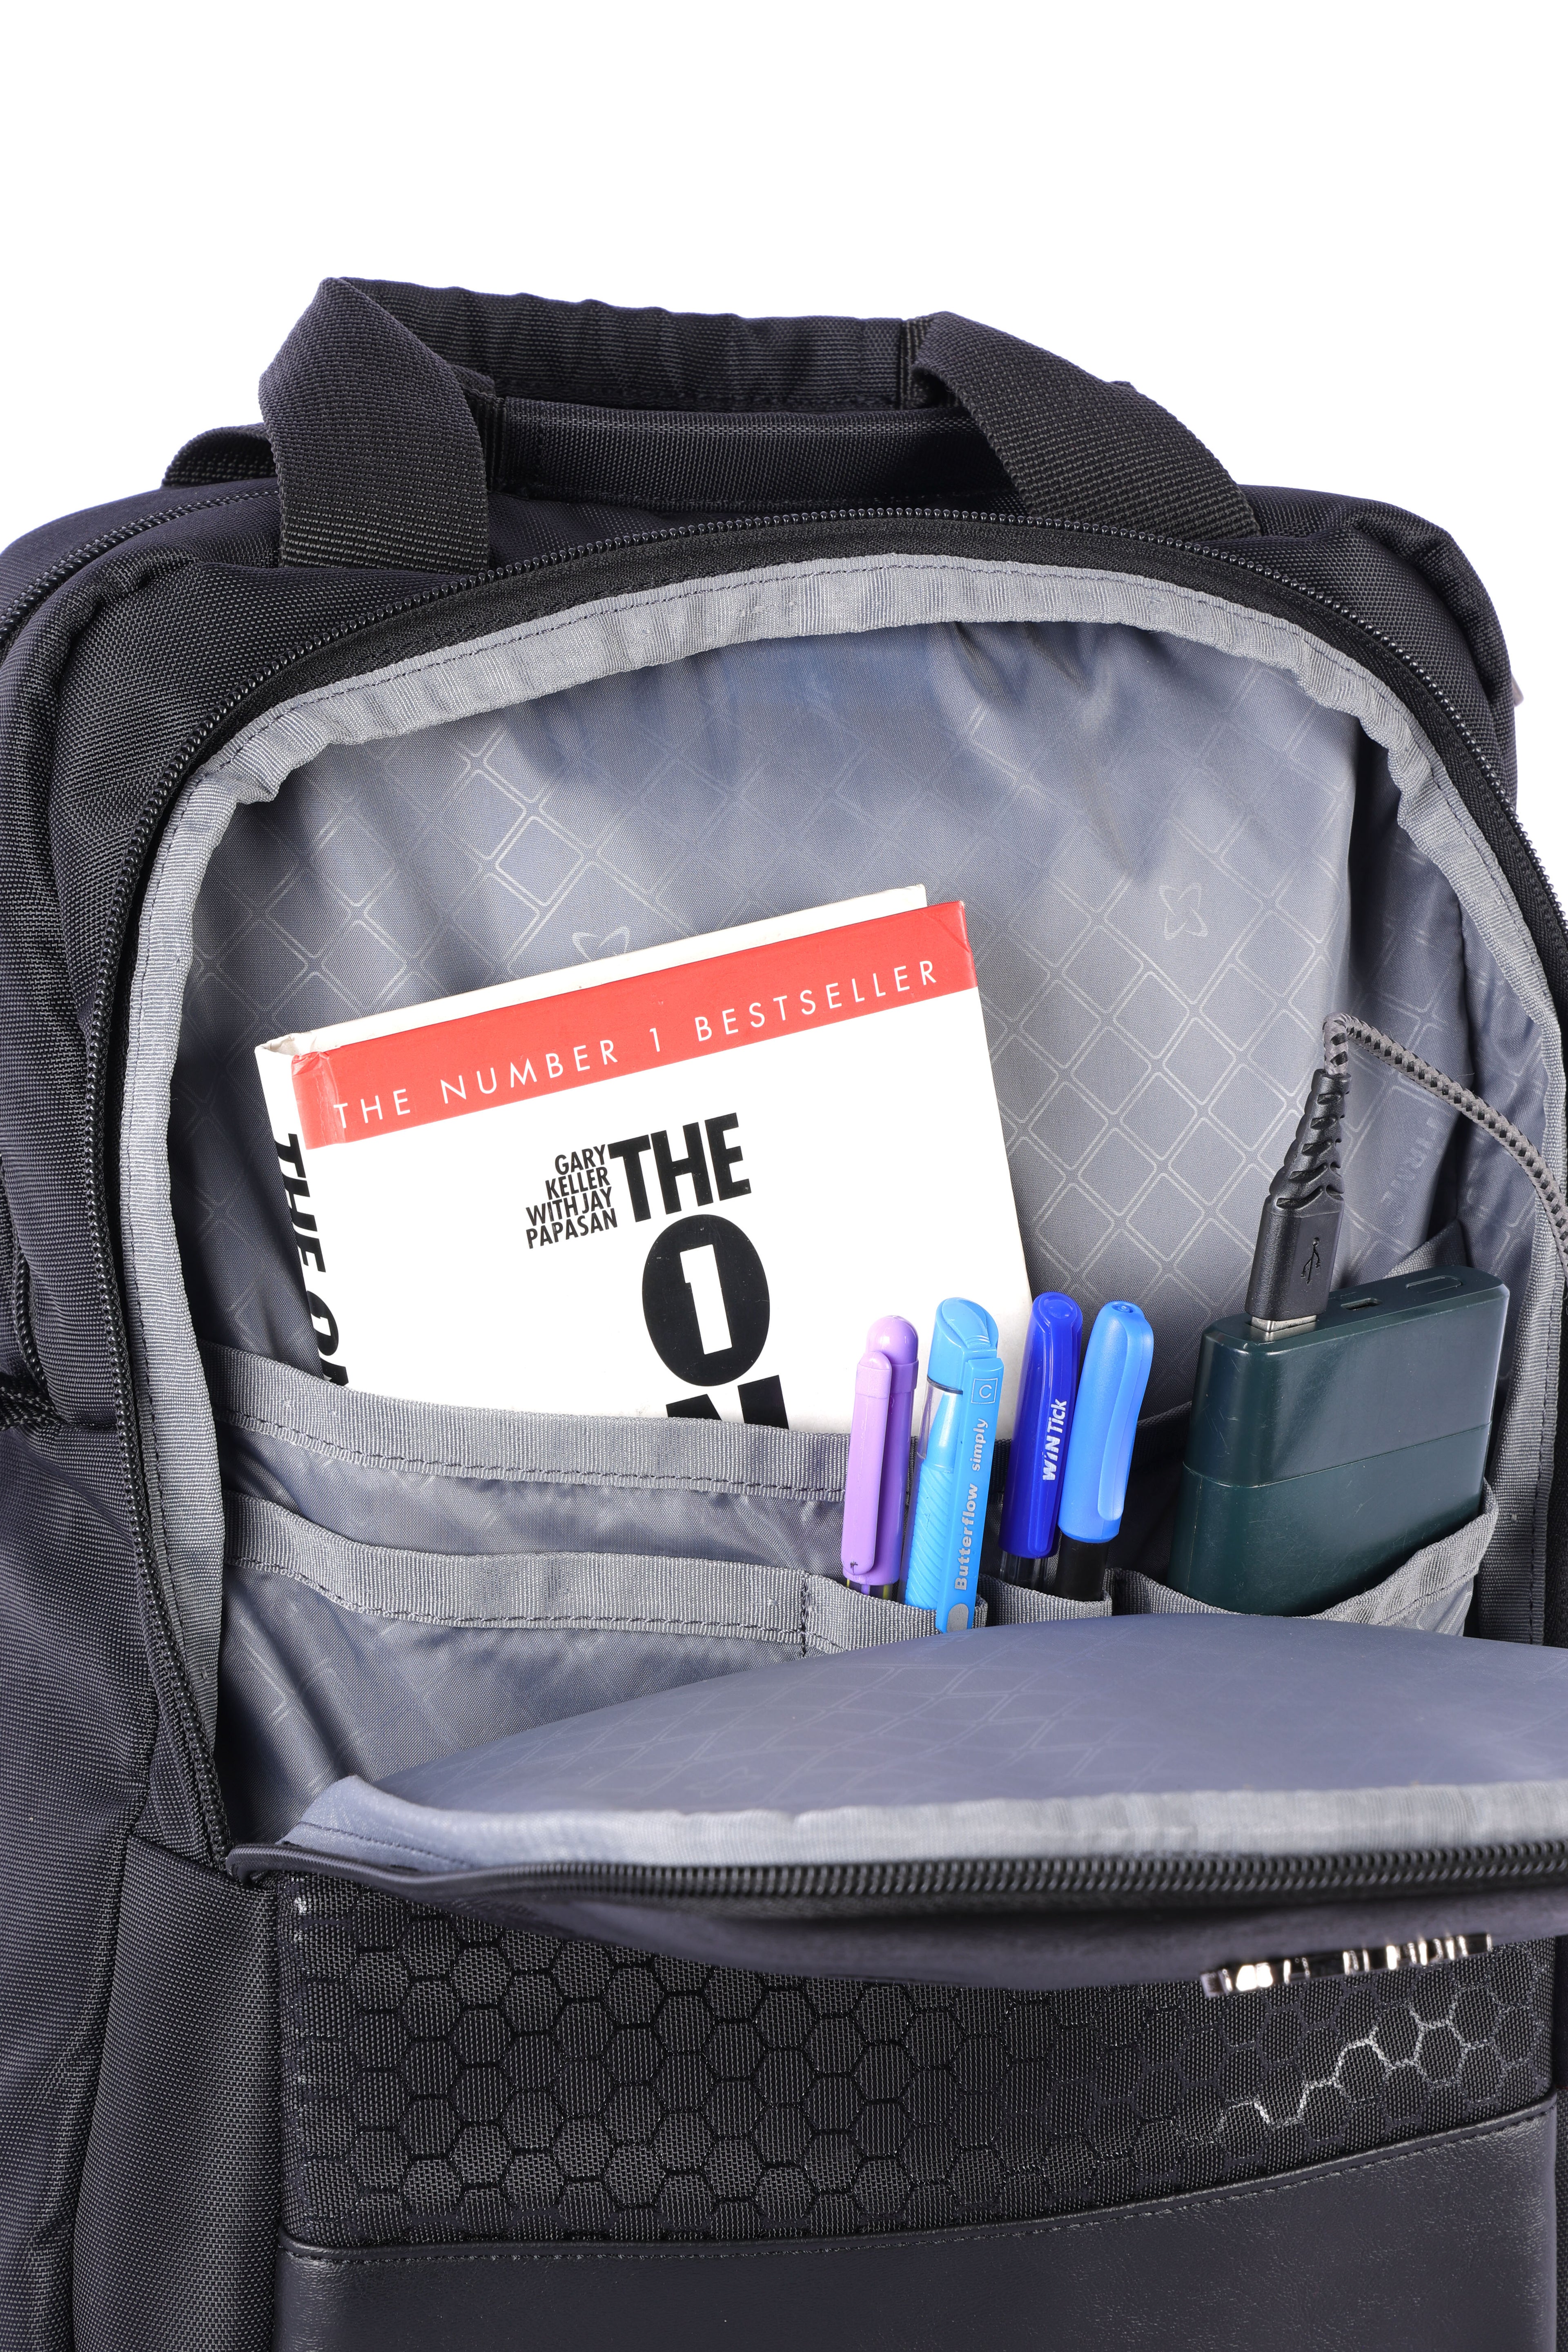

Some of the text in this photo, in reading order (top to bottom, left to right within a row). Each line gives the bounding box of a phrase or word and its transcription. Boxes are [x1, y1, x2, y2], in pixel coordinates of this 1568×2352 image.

[333, 960, 937, 1129] THE NUMBER 1 BESTSELLER
[545, 1167, 610, 1200] KELLER
[555, 1144, 606, 1175] GARY
[607, 1112, 751, 1223] THE
[275, 1133, 326, 1273] THE
[526, 1186, 612, 1226] WITH JAY
[526, 1208, 618, 1249] PAPASAN
[954, 1418, 988, 1590] Butterflow simply
